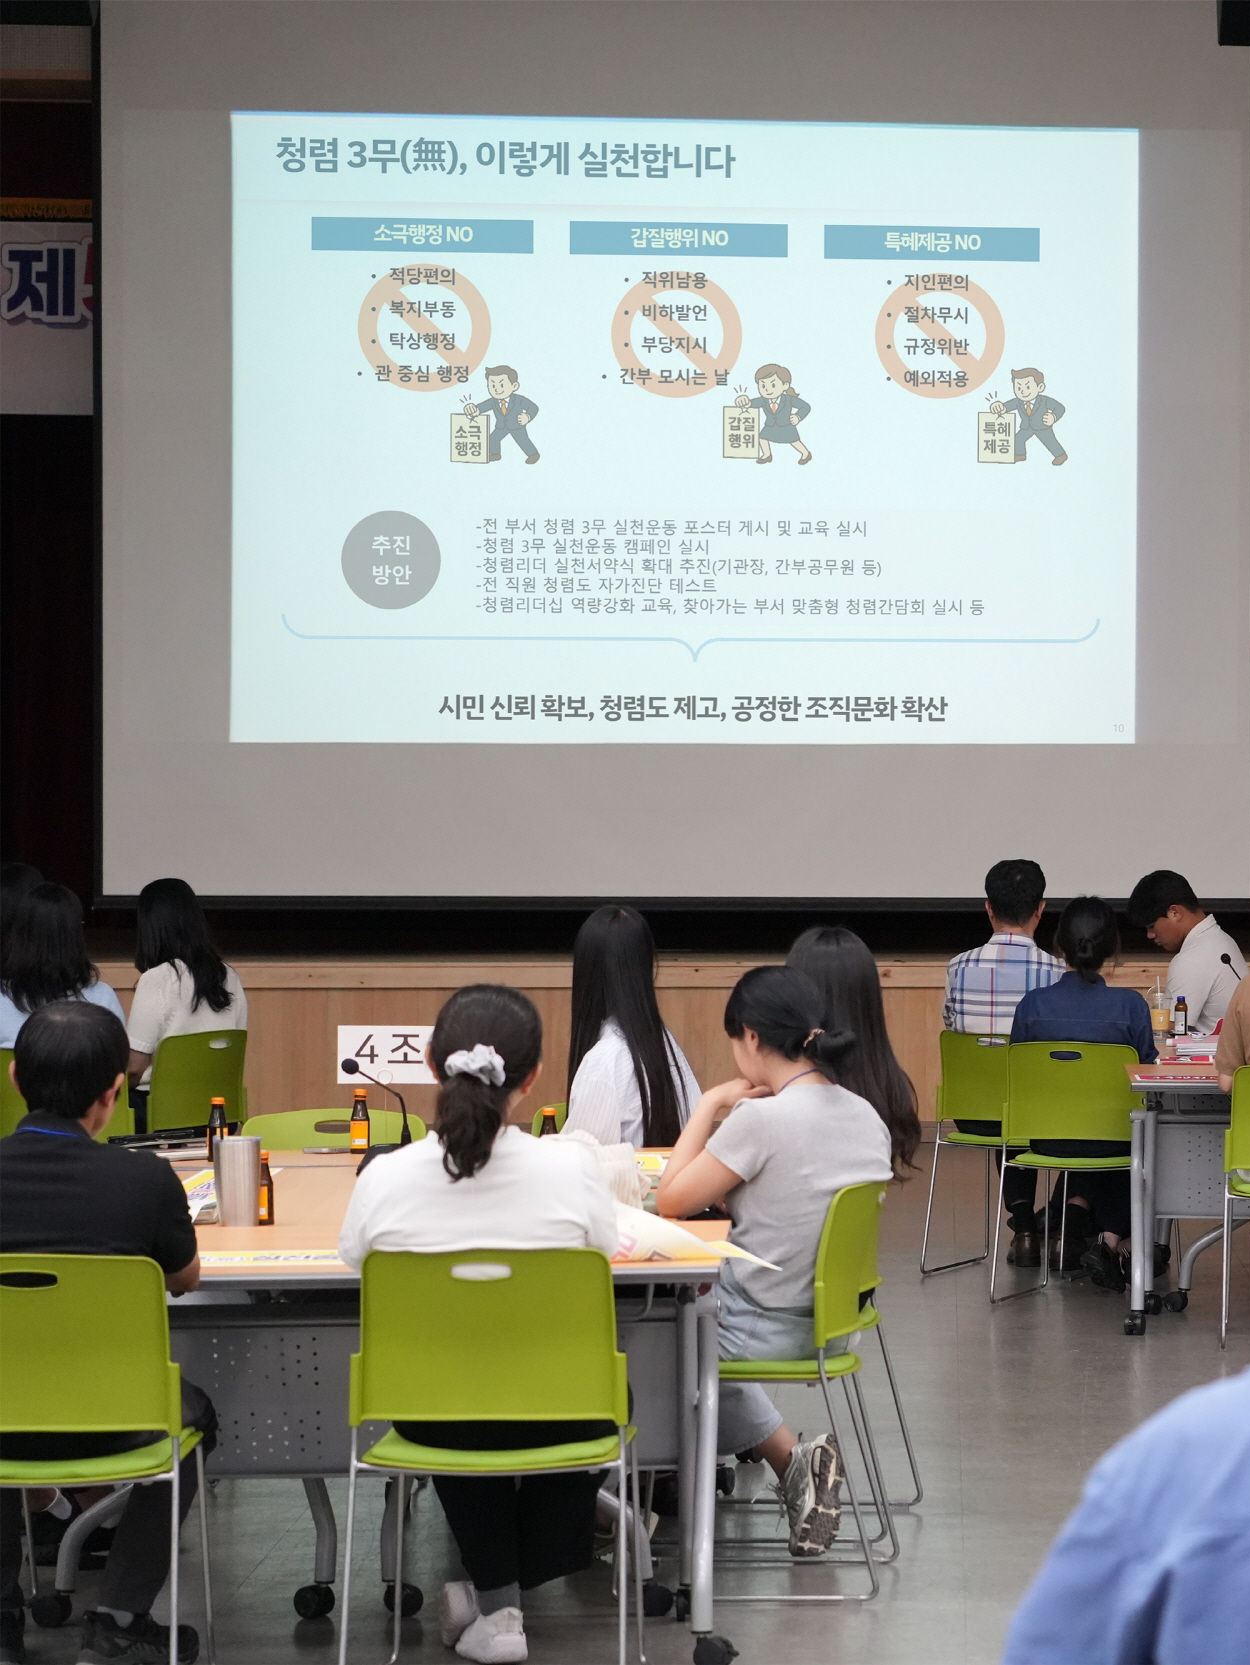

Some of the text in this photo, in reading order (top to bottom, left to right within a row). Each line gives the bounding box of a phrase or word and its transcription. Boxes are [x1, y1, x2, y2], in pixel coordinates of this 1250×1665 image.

[275, 136, 338, 173] 청렴
[475, 140, 570, 178] 이렇게
[577, 142, 737, 179] 실천합니다
[373, 224, 474, 245] 소극행정 NO
[630, 227, 729, 249] 갑질행위 NO
[884, 231, 982, 253] 특혜제공 NO
[7, 246, 93, 318] 제
[389, 266, 456, 286] 적당편의
[641, 270, 709, 290] 직위남용
[904, 273, 969, 292] 지인편의
[388, 299, 457, 319] 복지부동
[642, 303, 707, 322] 비하발언
[904, 305, 968, 325] 절차무시
[389, 332, 456, 351] 탁상행정
[641, 335, 707, 355] 부당지시
[903, 337, 970, 356] 규정위반
[374, 364, 469, 384] 관 중심 행정
[619, 367, 730, 387] 간부 모시는 날
[903, 369, 970, 389] 예외적용
[454, 425, 482, 441] 소극
[728, 416, 755, 432] 갑질
[982, 421, 1011, 437] 특혜
[454, 441, 482, 457] 행정
[728, 432, 755, 449] 행위
[983, 438, 1011, 454] 제공
[475, 517, 867, 538] -전 부서 청렴 3무 실천운동 포스터 게시 및 교육 실시
[371, 534, 411, 556] 추진
[476, 537, 709, 556] -청렴 3무 실천운동 캠페인 실시
[372, 564, 413, 586] 방안
[475, 556, 882, 578] -청렴리더 실천서약식 확대 추진(기관장, 간부공무원 등)
[475, 576, 717, 595] -전 직원 청렴도 자가진단 테스트
[475, 596, 985, 616] -청렴리더십 역량강화 교육, 찾아가는 부서 맞춤형 청렴간담회 실시 등
[438, 694, 949, 723] 시민 신뢰 확보, 청렴도 제고, 공정한 조직문화 확산
[1113, 723, 1125, 733] 10
